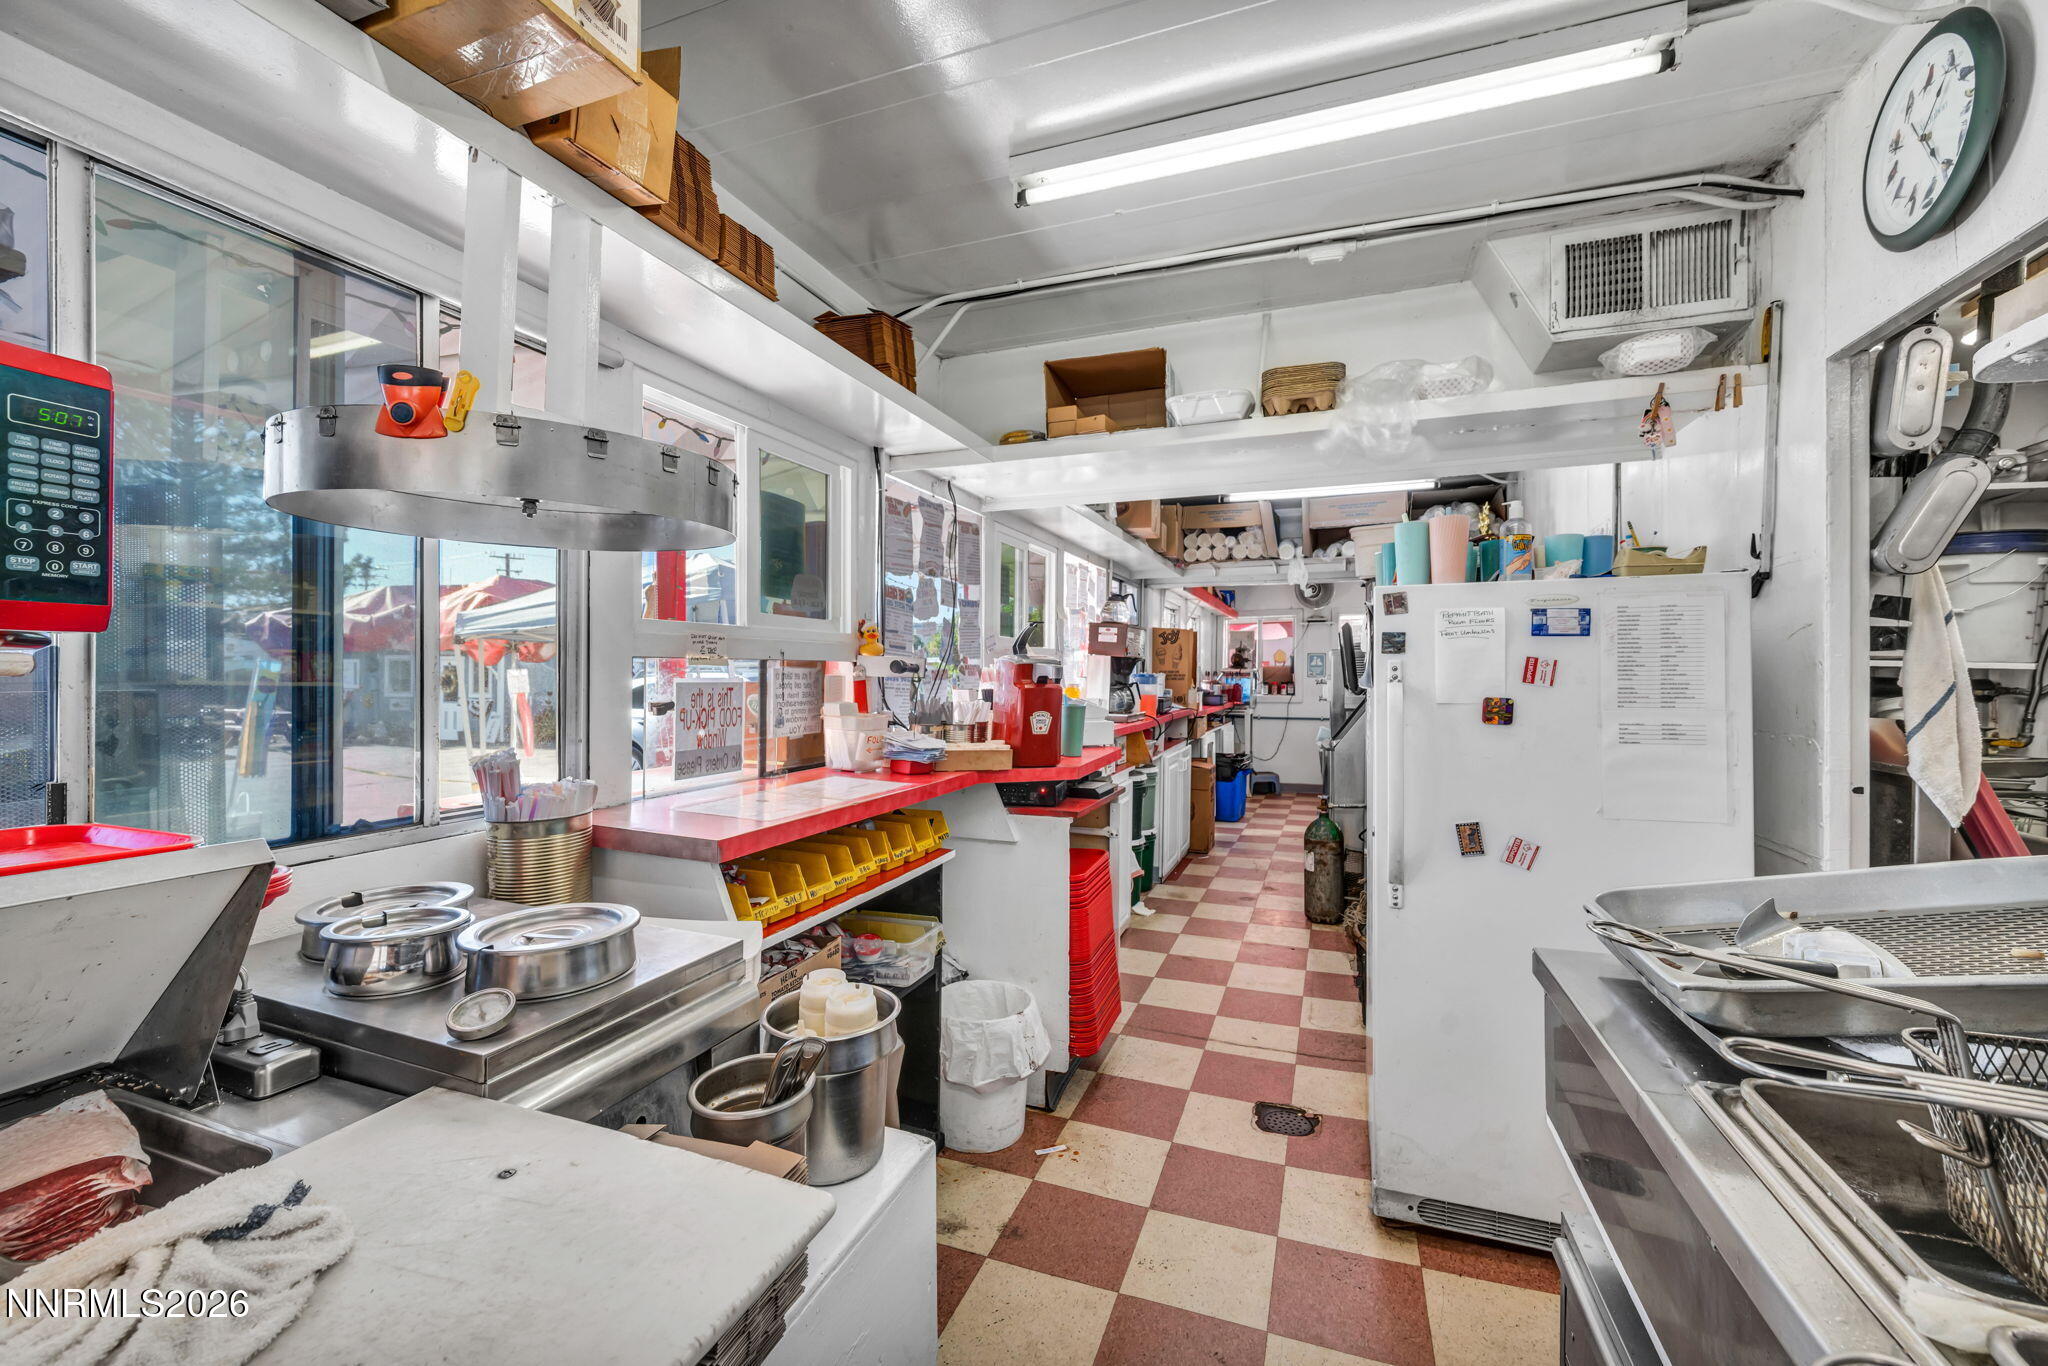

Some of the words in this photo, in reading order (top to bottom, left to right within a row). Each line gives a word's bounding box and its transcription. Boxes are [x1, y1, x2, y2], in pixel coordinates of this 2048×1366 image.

[32, 499, 60, 507] EXPRESS
[19, 506, 26, 514] 1
[52, 527, 59, 535] 5
[52, 544, 59, 552] 8
[10, 556, 36, 564] STOP
[72, 562, 97, 570] START
[1508, 837, 1521, 863] SUPPORTER
[783, 892, 803, 907] SALT
[780, 968, 798, 986] HEINZ
[771, 983, 790, 998] TOMATO
